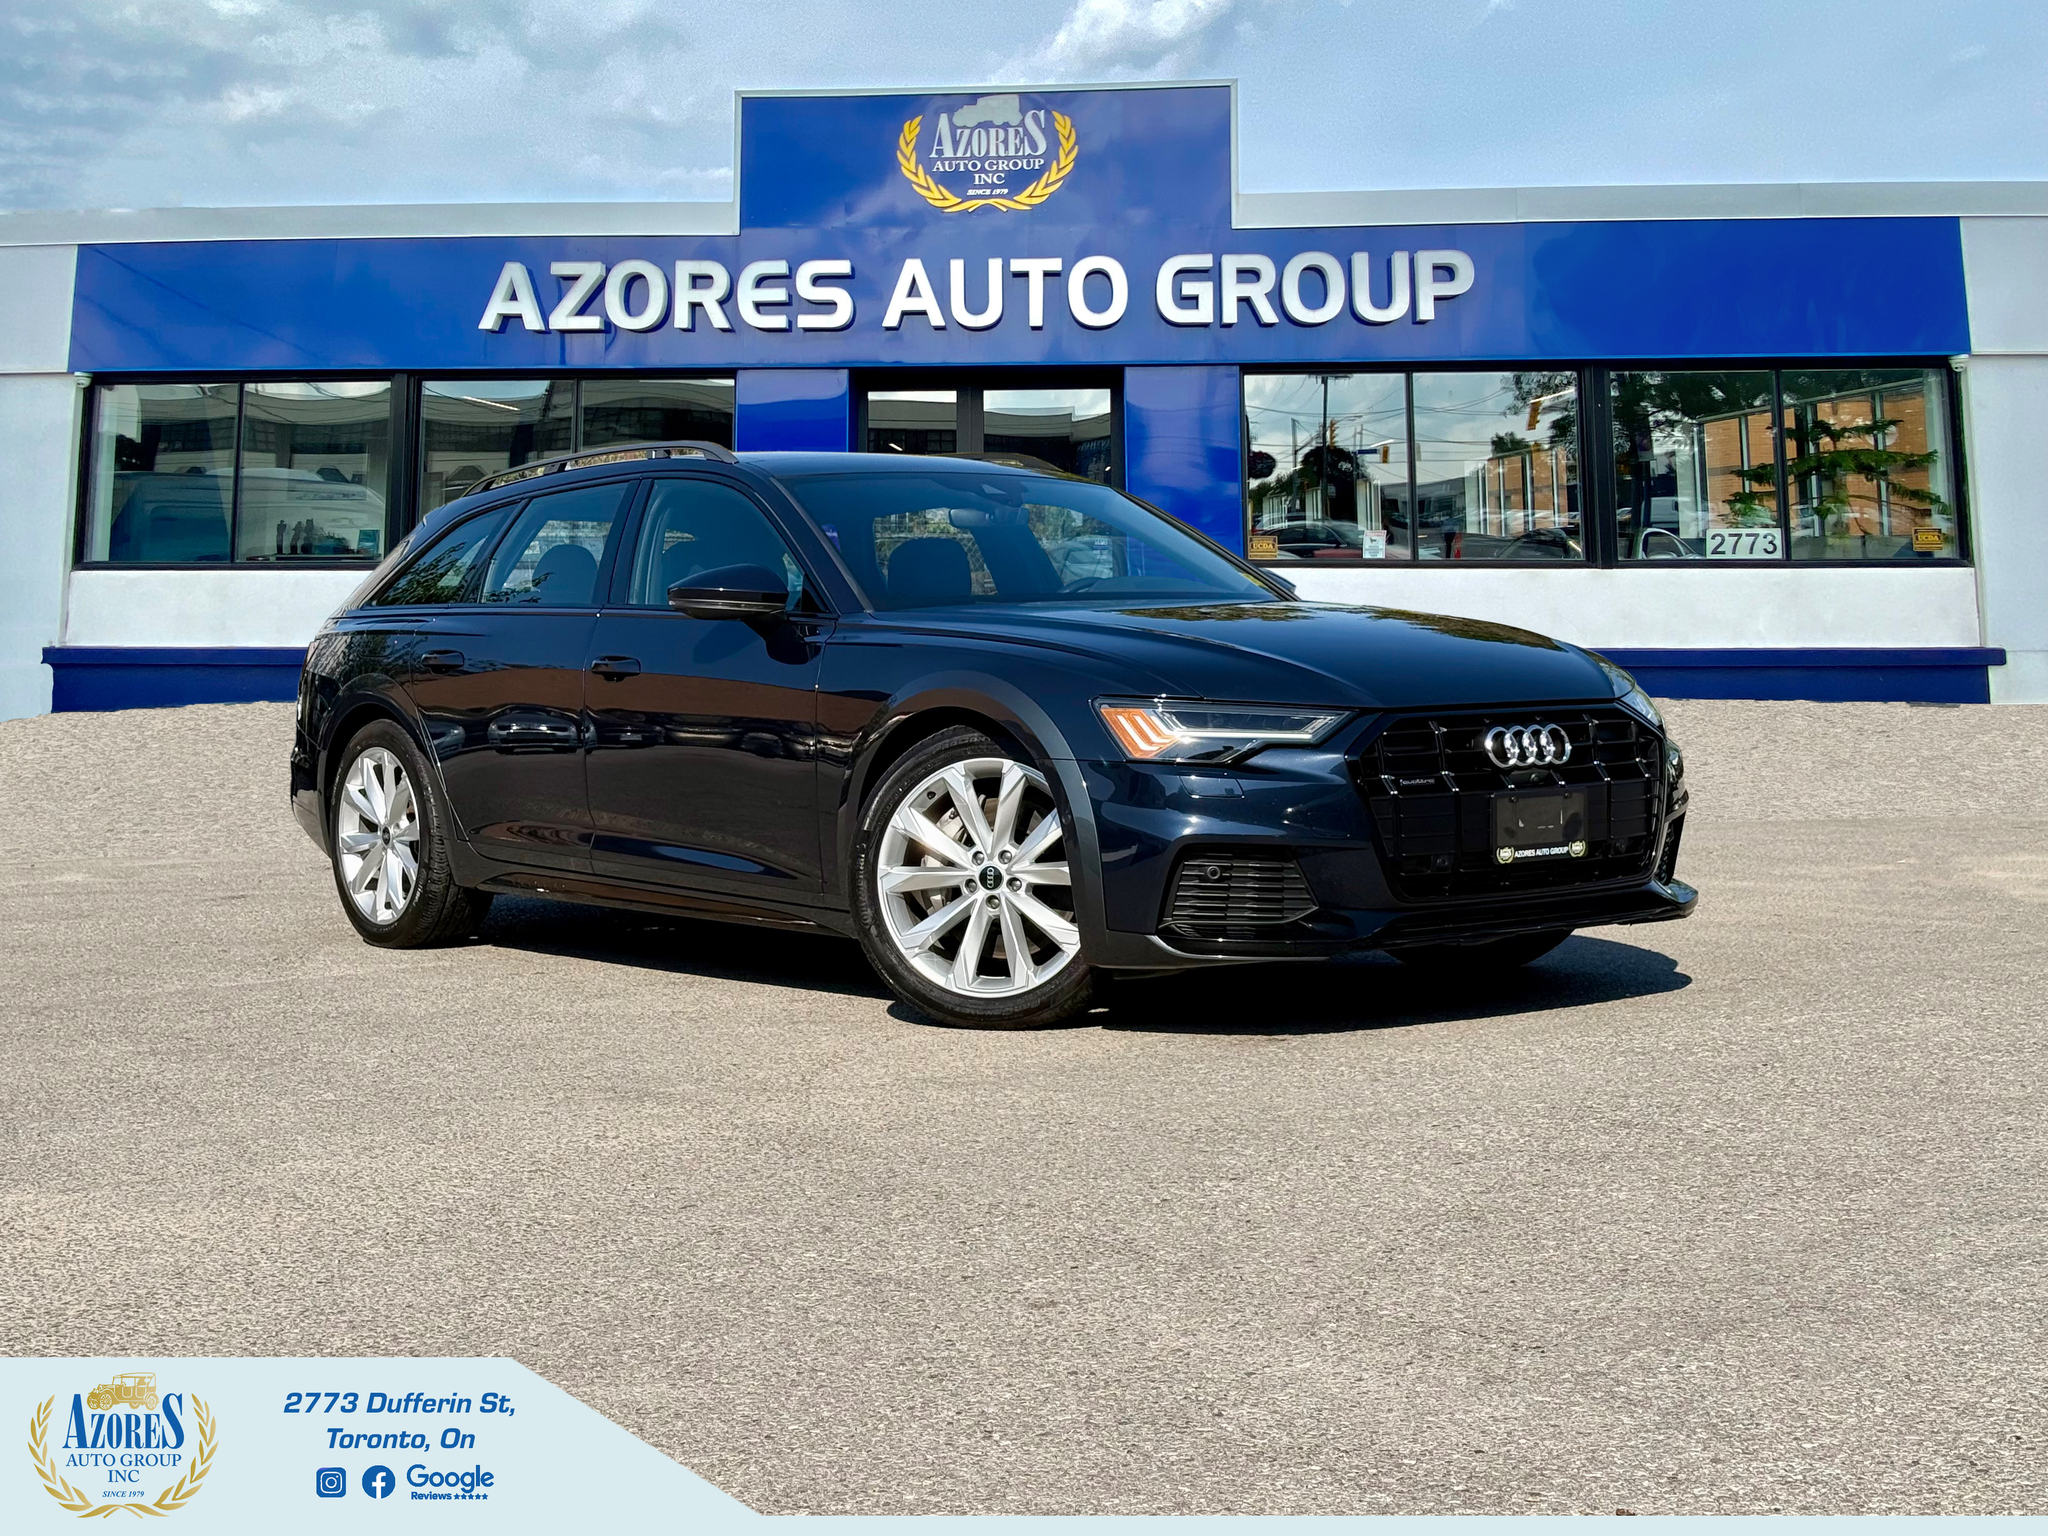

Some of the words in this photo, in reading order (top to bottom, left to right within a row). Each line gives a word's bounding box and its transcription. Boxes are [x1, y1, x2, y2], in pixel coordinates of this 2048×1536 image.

[929, 110, 1047, 158] AZORES
[932, 159, 980, 172] AUTO
[984, 158, 1044, 171] GROUP
[973, 173, 1005, 185] INC
[966, 188, 991, 196] SINCE
[478, 259, 854, 332] AZORES
[882, 255, 1128, 330] AUTO
[1156, 249, 1475, 326] GROUP
[1710, 532, 1778, 556] 2773
[1515, 850, 1535, 858] AZORES
[1536, 848, 1550, 856] AUTO
[1550, 847, 1568, 855] GROUP
